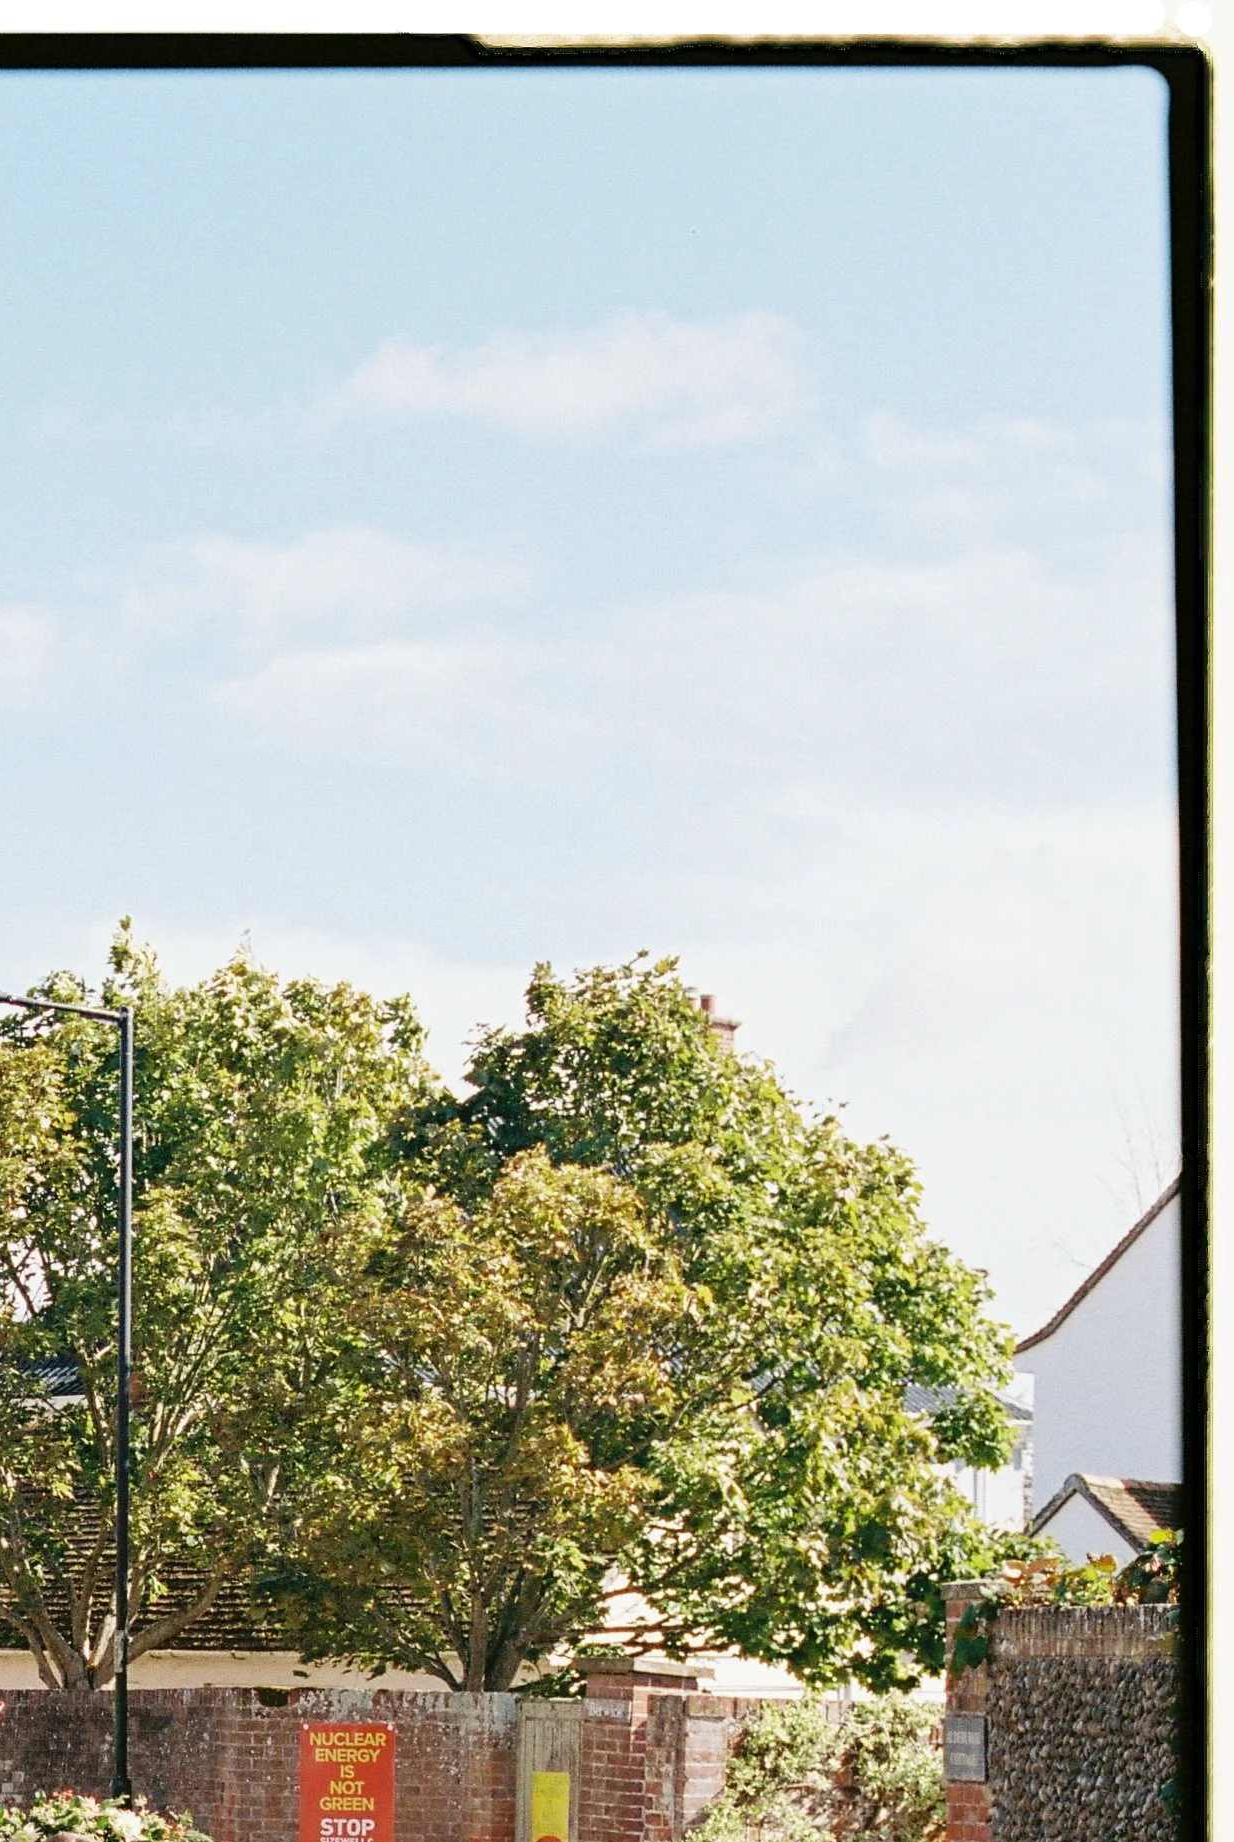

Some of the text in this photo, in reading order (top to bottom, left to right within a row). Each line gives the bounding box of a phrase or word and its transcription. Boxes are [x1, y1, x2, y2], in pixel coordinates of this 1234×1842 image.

[309, 1732, 386, 1747] NUCLEAR
[315, 1748, 380, 1763] ENERGY
[340, 1764, 355, 1779] IS
[330, 1780, 365, 1795] NOT
[319, 1796, 374, 1811] GREEN
[320, 1818, 375, 1836] STOP
